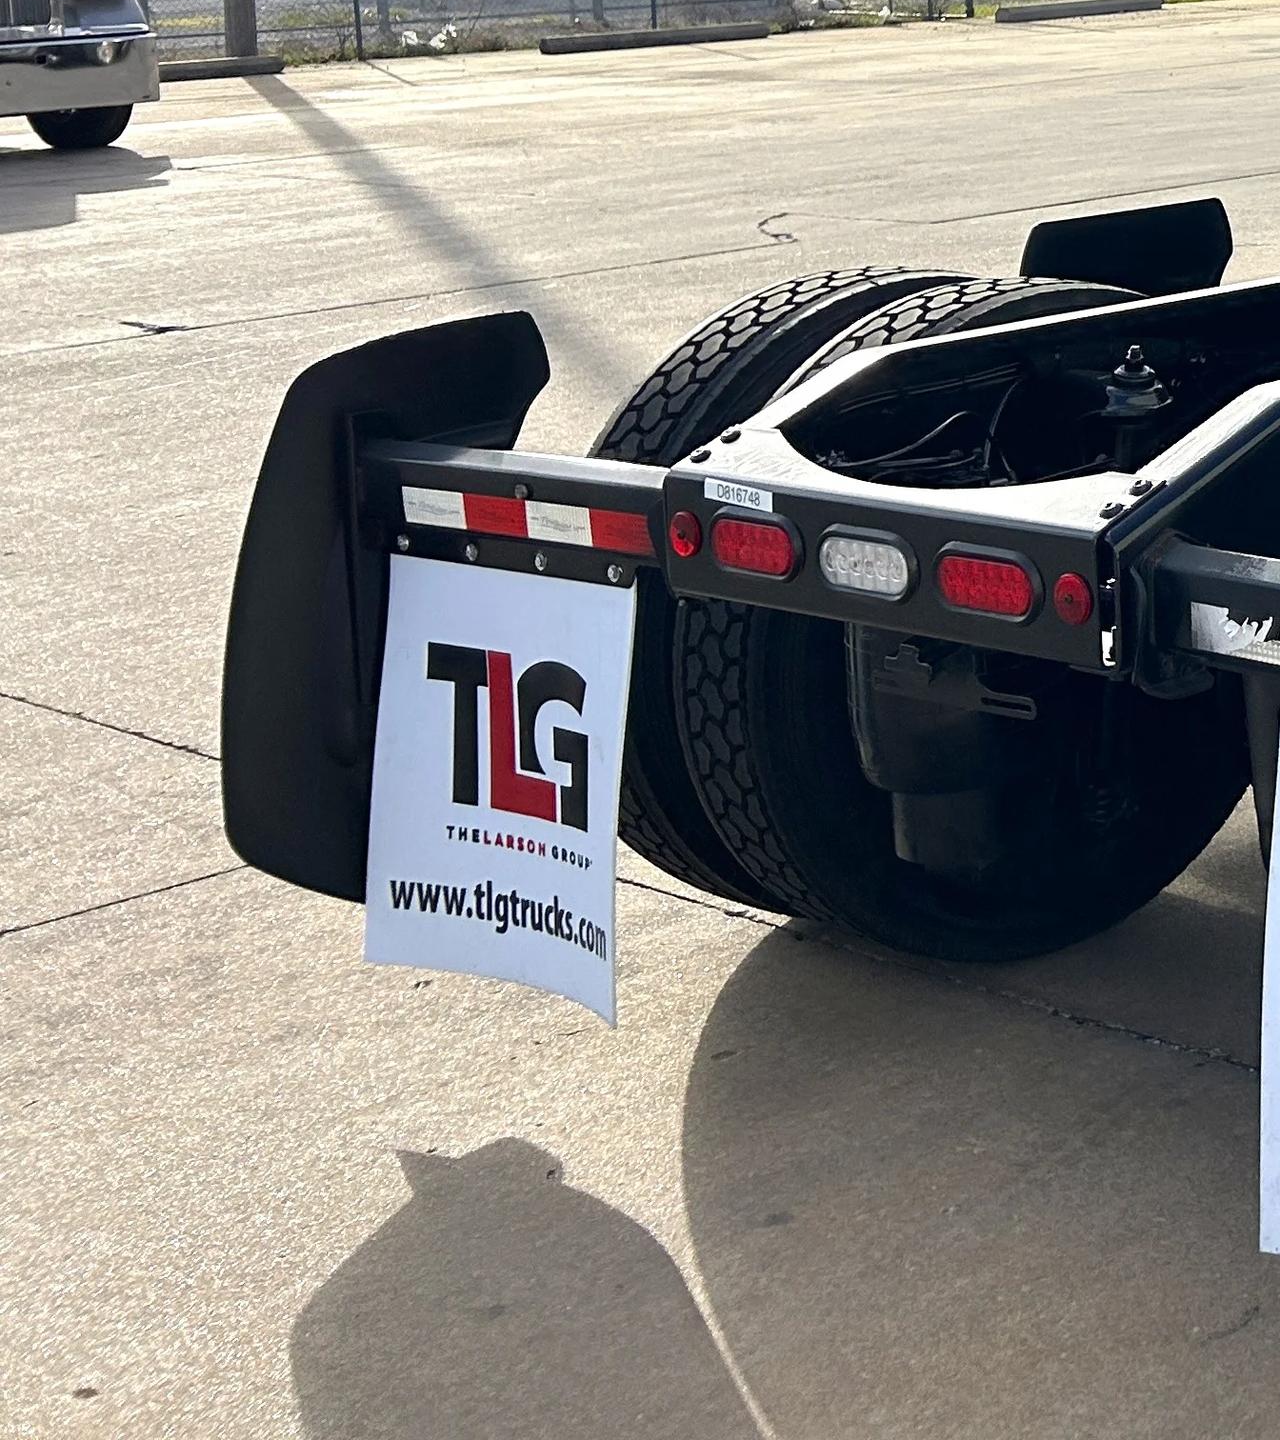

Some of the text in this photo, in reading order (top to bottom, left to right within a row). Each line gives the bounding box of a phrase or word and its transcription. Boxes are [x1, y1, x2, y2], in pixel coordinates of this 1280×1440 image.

[427, 641, 588, 833] TLG
[551, 845, 590, 871] GROUP
[390, 880, 607, 961] www.tlgtrucks.com
